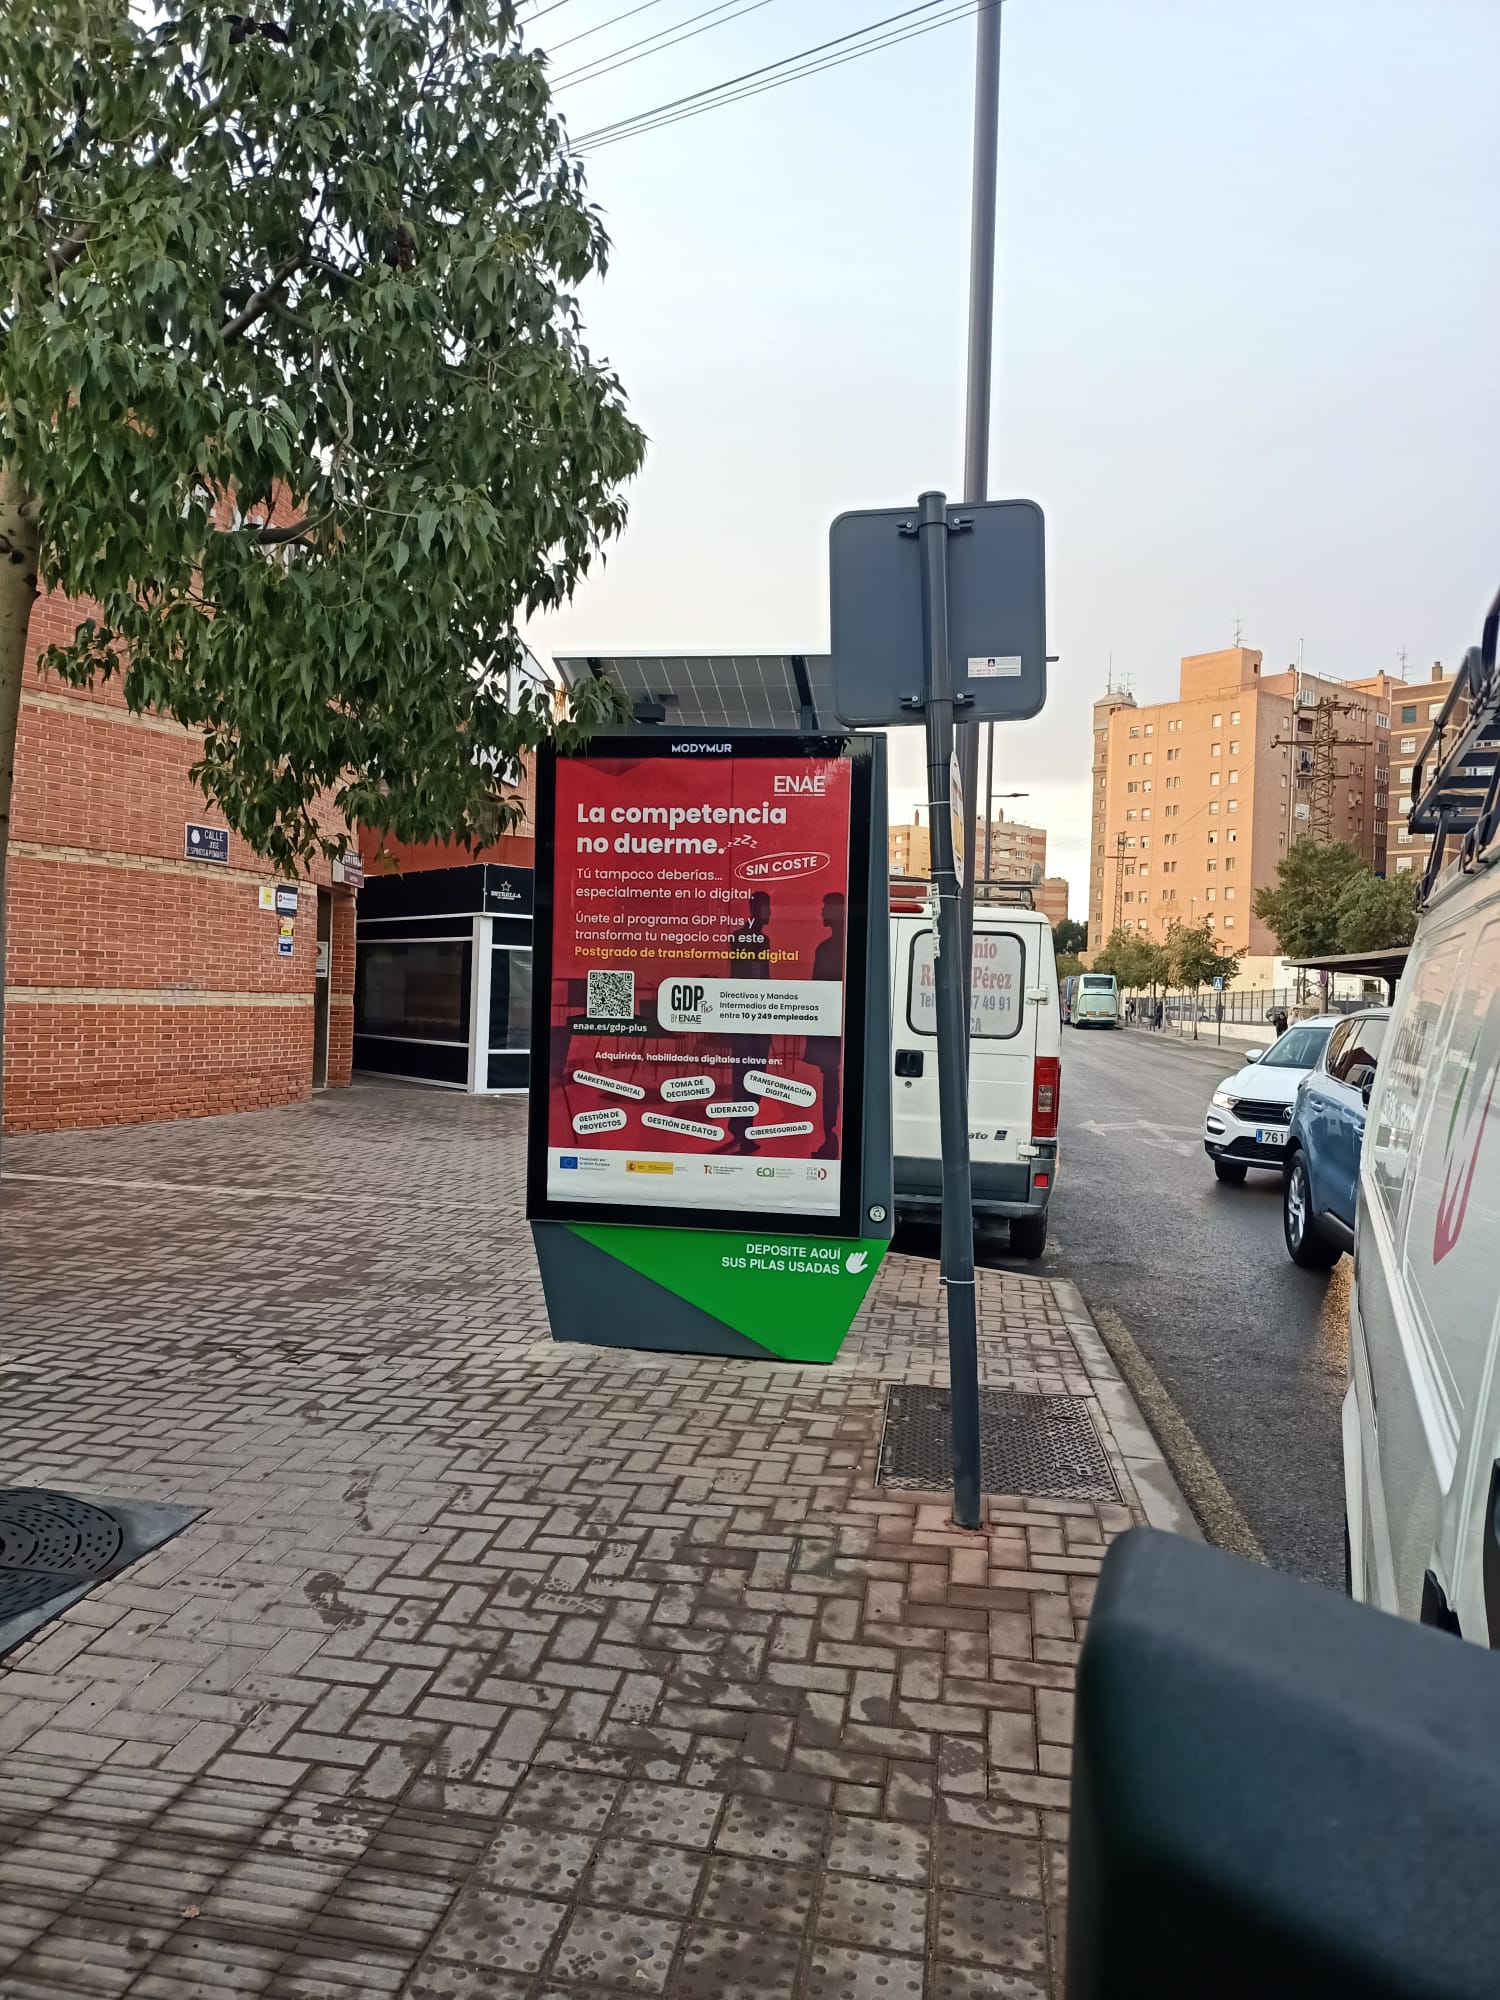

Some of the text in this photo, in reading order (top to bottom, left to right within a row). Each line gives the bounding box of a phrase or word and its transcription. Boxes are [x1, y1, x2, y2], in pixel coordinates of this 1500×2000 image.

[671, 743, 732, 753] MODYMUR
[774, 775, 826, 793] ENAE
[577, 801, 787, 830] La competencia
[204, 830, 224, 842] CALLE
[577, 833, 725, 854] no duerme.
[745, 856, 818, 876] SIN COSTE
[576, 867, 723, 882] Tú tampoco deberías...
[575, 886, 755, 902] especialmente en lo digital.
[575, 910, 756, 929] Únete al programa GDP Plus y
[575, 929, 765, 944] transforma tu negocio con este
[574, 946, 799, 964] Postgrado de transformación digital
[972, 966, 1012, 990] Pérez
[671, 984, 704, 1012] GDP
[719, 991, 759, 1000] Directivos
[766, 992, 799, 1000] Mandos
[982, 995, 996, 1011] 49
[998, 995, 1011, 1011] 91
[719, 1002, 768, 1010] Intermedios
[780, 1003, 819, 1012] Empresas
[678, 1014, 702, 1023] ENAE
[741, 1012, 750, 1020] 10
[757, 1012, 772, 1020] 249
[773, 1013, 819, 1022] empleados
[572, 1022, 648, 1033] enae.es/gdp-plus
[646, 1053, 700, 1063] habilidades
[700, 1054, 741, 1066] digitales
[741, 1056, 767, 1065] clave
[767, 1058, 783, 1066] en:
[576, 1073, 641, 1096] MARKETING DIGITAL
[670, 1080, 693, 1089] TOMA
[749, 1074, 812, 1097] TRANSFORMACIÓN
[666, 1088, 711, 1099] DECISIONES
[765, 1087, 791, 1100] DIGITAL
[579, 1112, 610, 1122] GESTIÓN
[710, 1105, 755, 1114] LIDERAZGO
[579, 1119, 622, 1131] PROYECTOS
[647, 1116, 718, 1137] GESTIÓN DE DATOS
[750, 1124, 808, 1136] CIBERSEGURIDAD
[1264, 1132, 1285, 1144] 761
[746, 1243, 841, 1260] DEPOSITE AQUÍ
[721, 1256, 840, 1275] SUS PILAS USADAS
